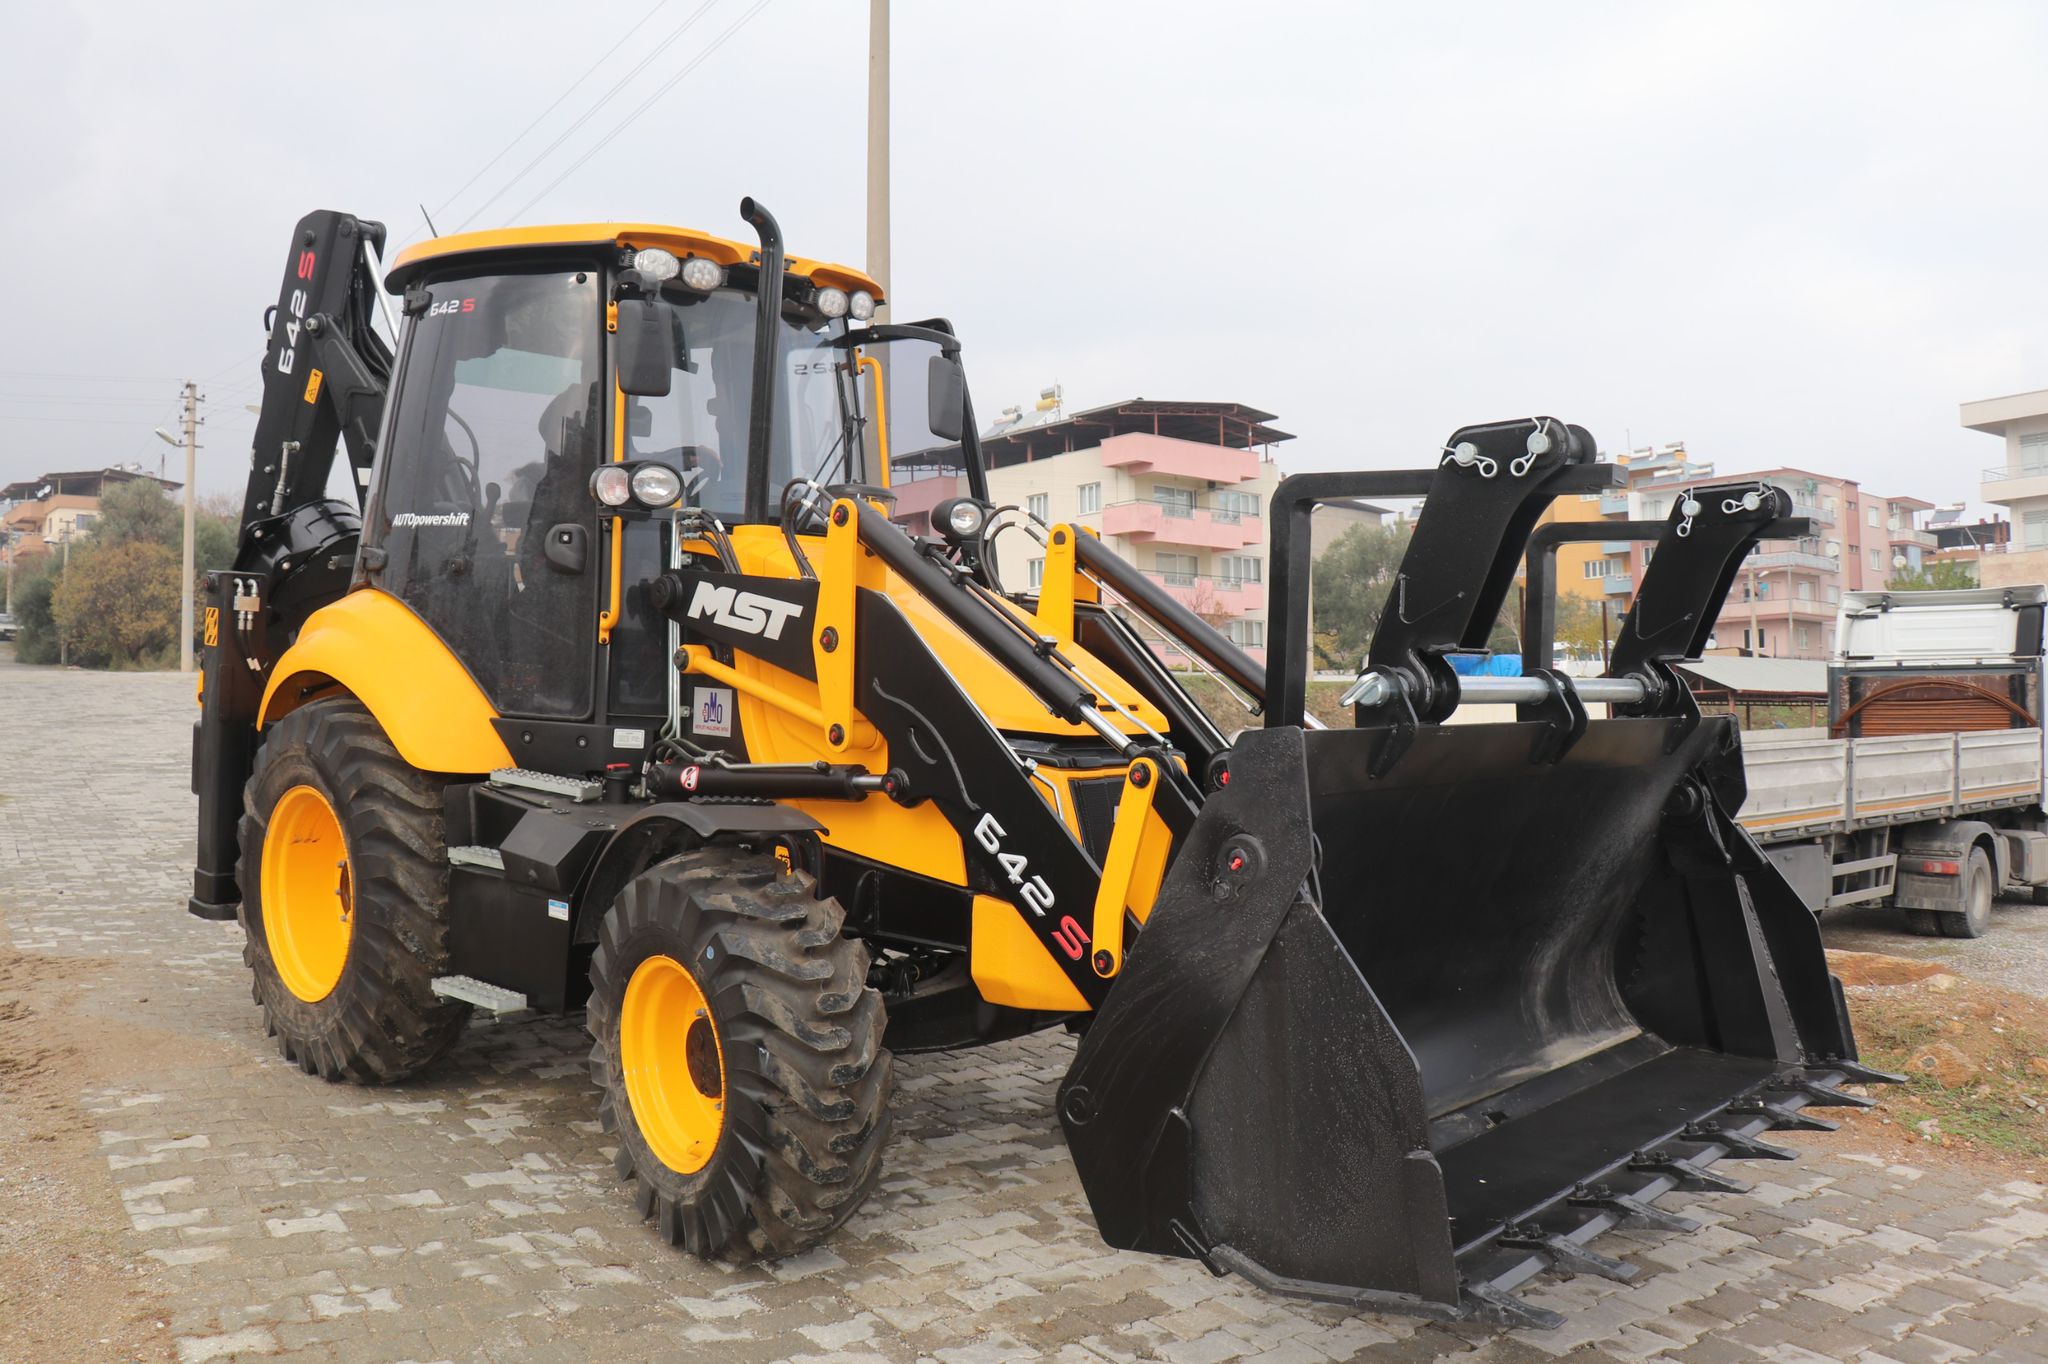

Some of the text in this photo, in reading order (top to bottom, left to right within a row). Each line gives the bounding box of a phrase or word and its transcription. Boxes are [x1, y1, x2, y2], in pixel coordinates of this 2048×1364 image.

[278, 250, 316, 374] 642 S
[429, 298, 477, 317] 642 S
[392, 512, 470, 529] AUTOpowershift
[687, 580, 804, 641] MST
[974, 812, 1092, 961] 642 S
